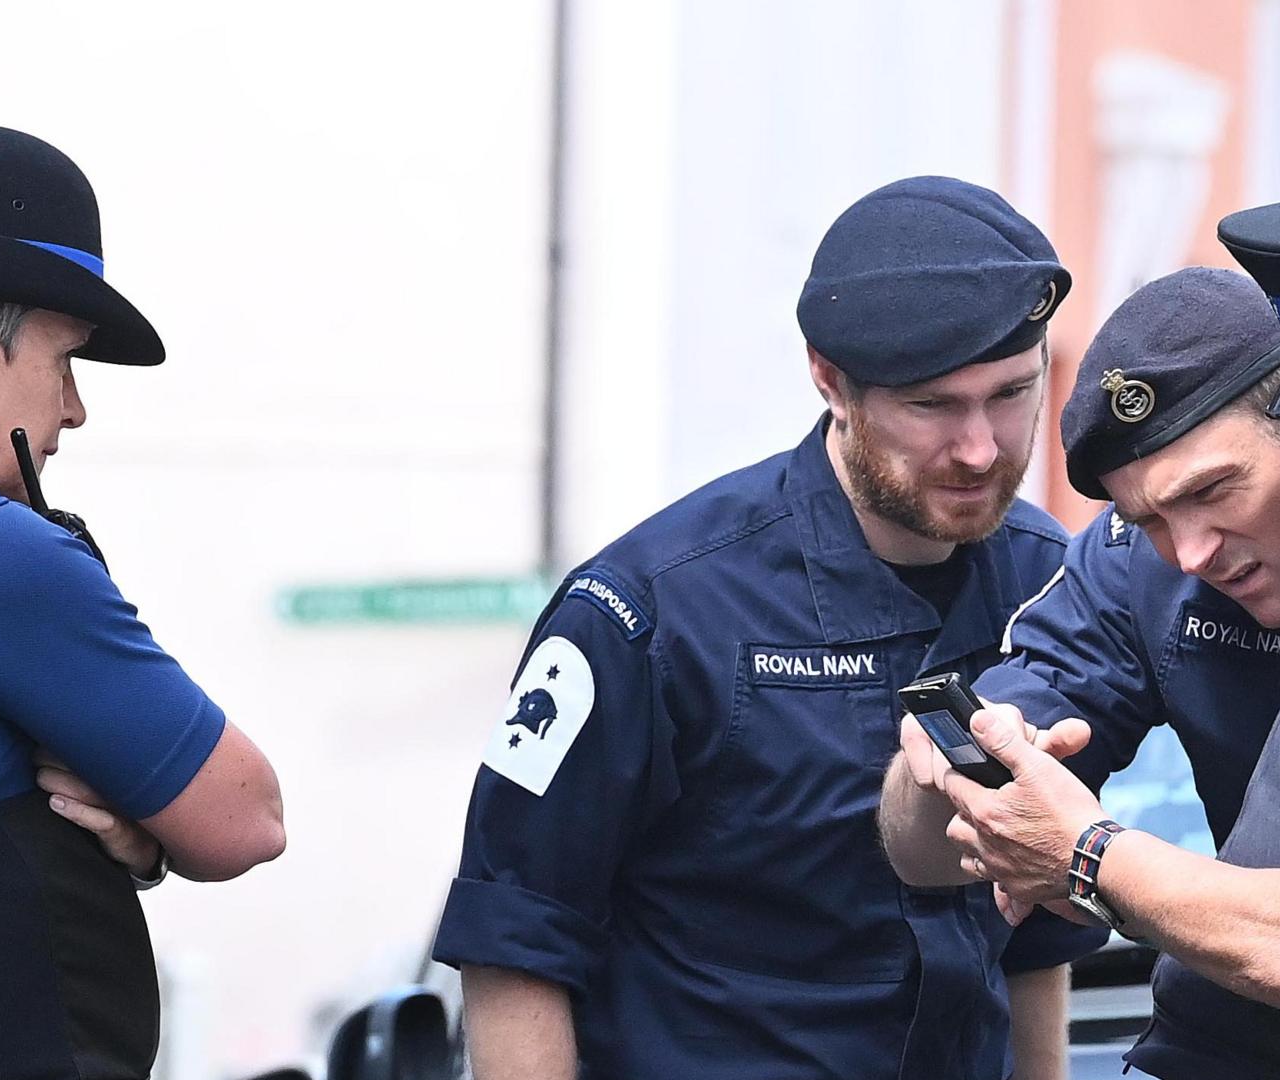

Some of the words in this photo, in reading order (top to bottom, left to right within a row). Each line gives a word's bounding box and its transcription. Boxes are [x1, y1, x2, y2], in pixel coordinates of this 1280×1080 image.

[588, 580, 638, 631] DISPOSAL
[1185, 616, 1251, 650] ROYAL
[754, 654, 821, 676] ROYAL
[823, 654, 876, 676] NAVY
